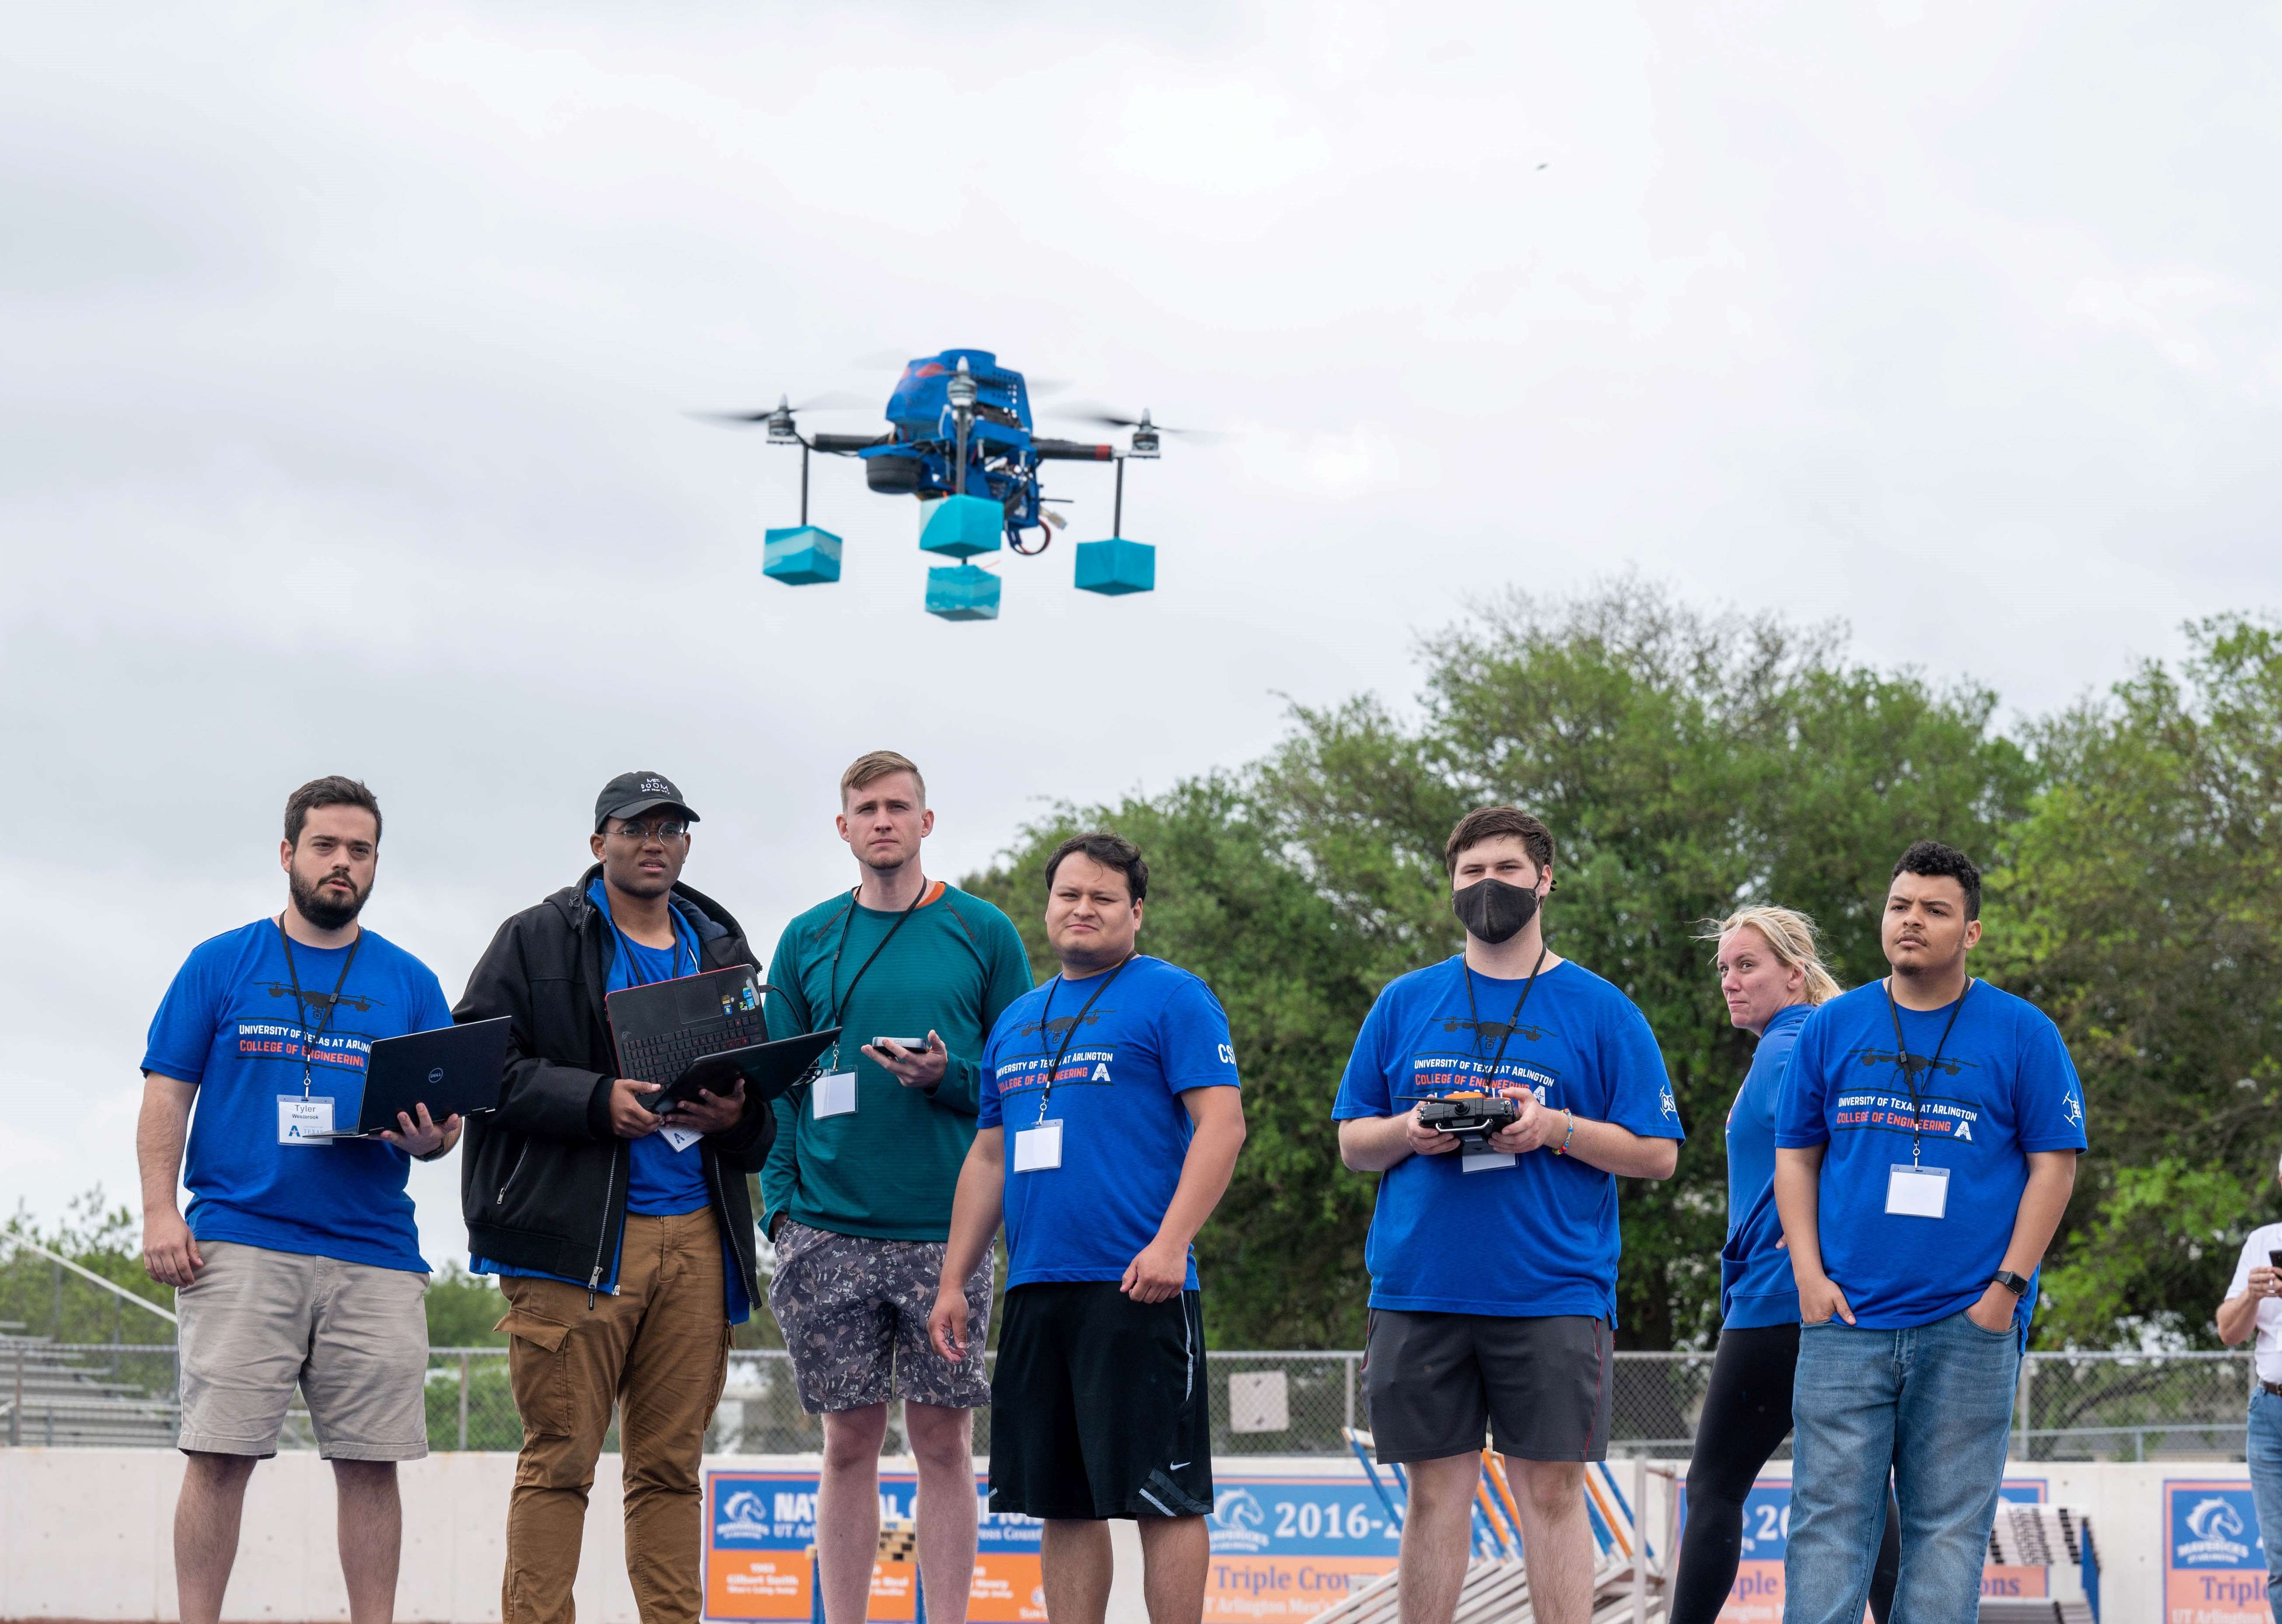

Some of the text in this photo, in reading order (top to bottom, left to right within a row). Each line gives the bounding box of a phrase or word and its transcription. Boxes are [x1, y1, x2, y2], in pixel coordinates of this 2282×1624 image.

[641, 783, 669, 791] DOOM
[239, 1025, 289, 1036] UNIVERSITY
[290, 1029, 301, 1039] OF
[304, 1031, 329, 1046] TEAS
[332, 1039, 344, 1047] AT
[240, 1040, 283, 1052] COLLEGE
[286, 1043, 298, 1055] OF
[1218, 1043, 1236, 1064] CS
[1029, 1061, 1037, 1070] OF
[1062, 1055, 1071, 1065] AT
[1072, 1052, 1113, 1063] ARLINGTON
[1025, 1075, 1035, 1085] OF
[1037, 1067, 1089, 1084] ENNEERING
[1414, 1059, 1458, 1069] UNIVERSITY
[1459, 1061, 1471, 1070] OF
[1500, 1066, 1511, 1074] AT
[1512, 1066, 1554, 1087] ARLINGTON
[1415, 1073, 1452, 1086] COLLEGE
[1454, 1075, 1467, 1085] OF
[295, 1105, 316, 1113] Tyler
[1837, 1111, 1869, 1124] COLLEGE
[1872, 1112, 1884, 1122] OF
[1839, 1096, 1876, 1107] UNIVERSITY
[1877, 1098, 1888, 1107] OF
[1920, 1104, 1931, 1113] AT
[1932, 1104, 1977, 1122] ARLINGTON
[1214, 1565, 1292, 1596] Triple
